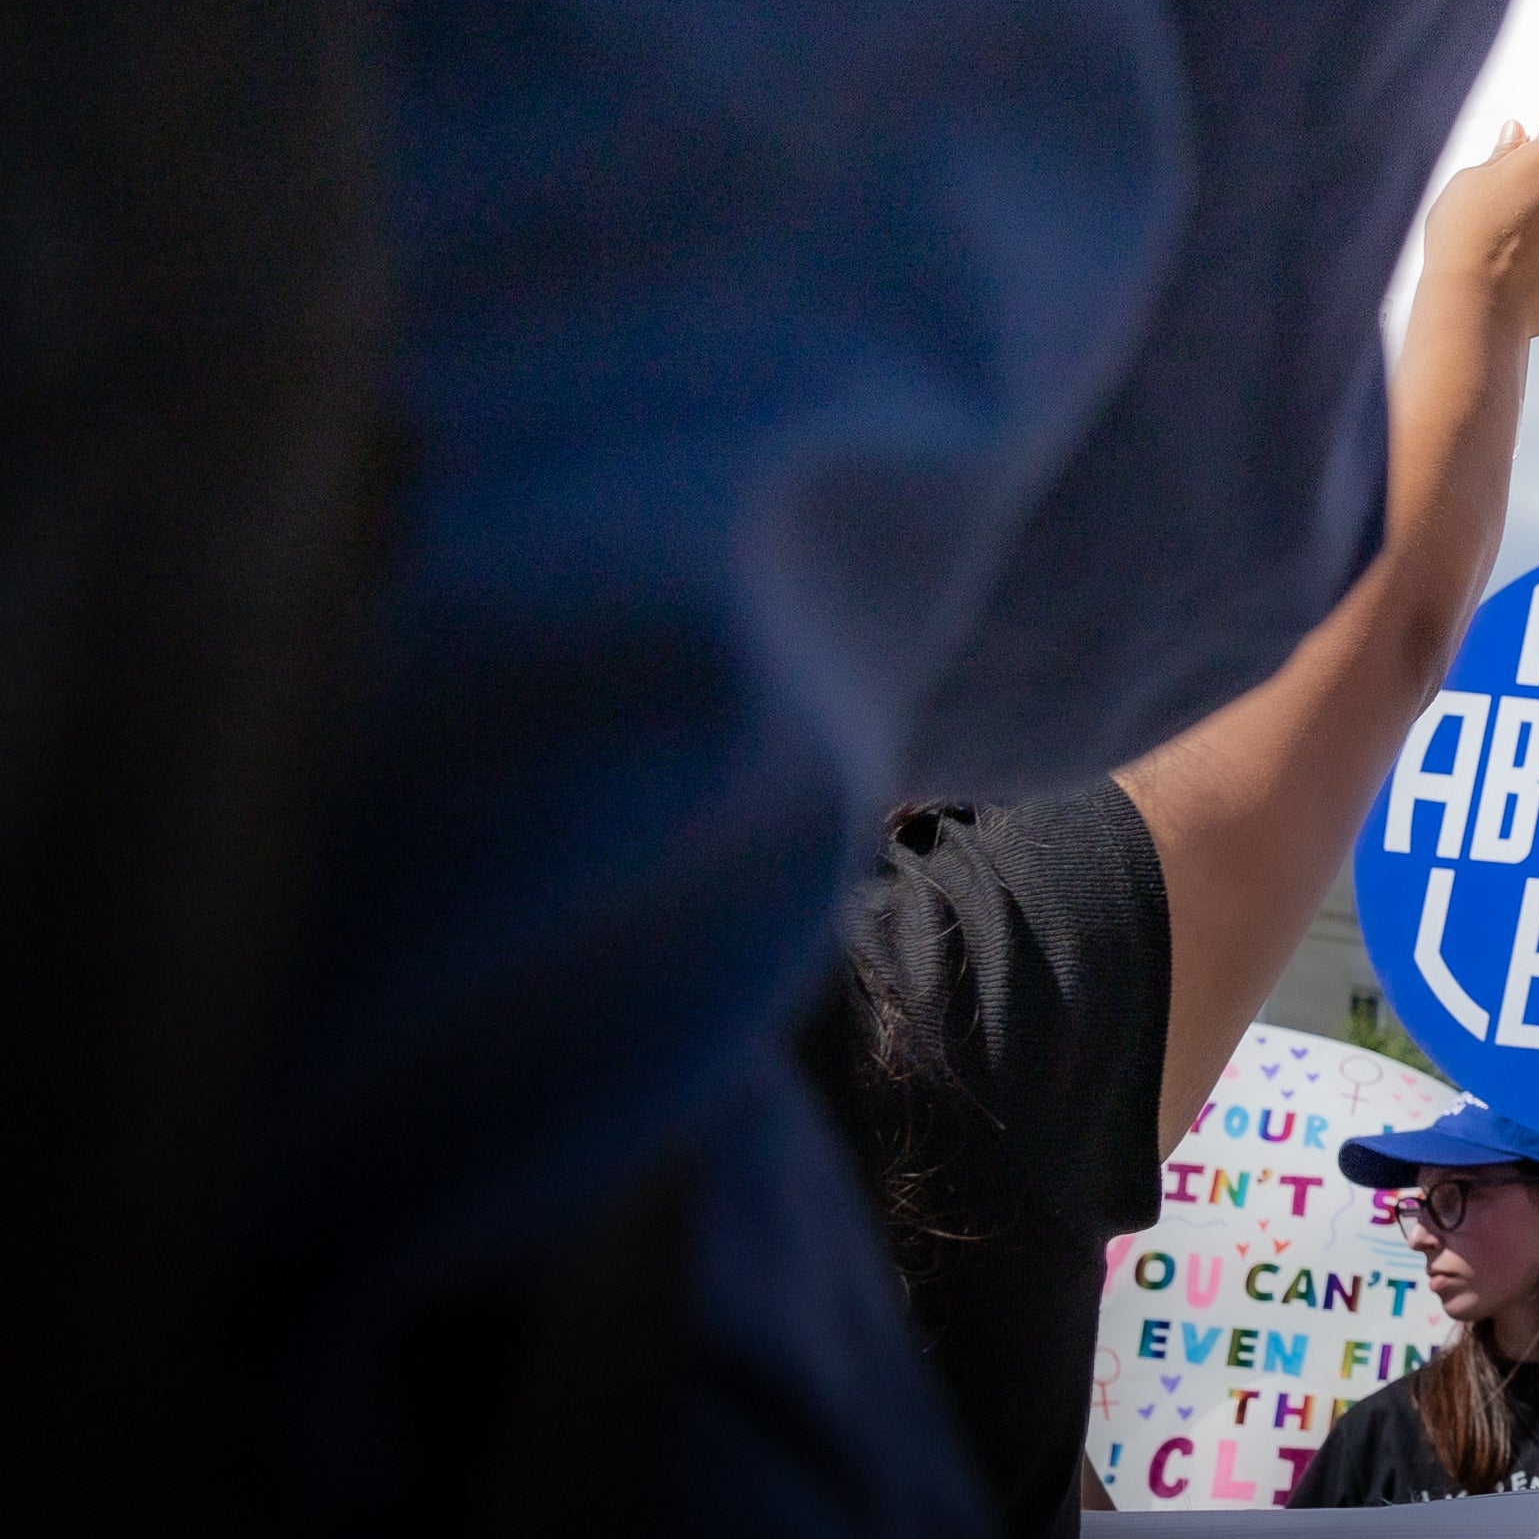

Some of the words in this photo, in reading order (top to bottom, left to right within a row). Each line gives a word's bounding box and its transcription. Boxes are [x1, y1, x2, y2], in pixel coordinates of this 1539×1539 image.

[1164, 1163, 1323, 1218] IN'T
[1245, 1262, 1417, 1318] CAN'T
[1138, 1319, 1309, 1378] EVEN
[1340, 1339, 1442, 1381] FIN
[1148, 1436, 1320, 1507] CLI
